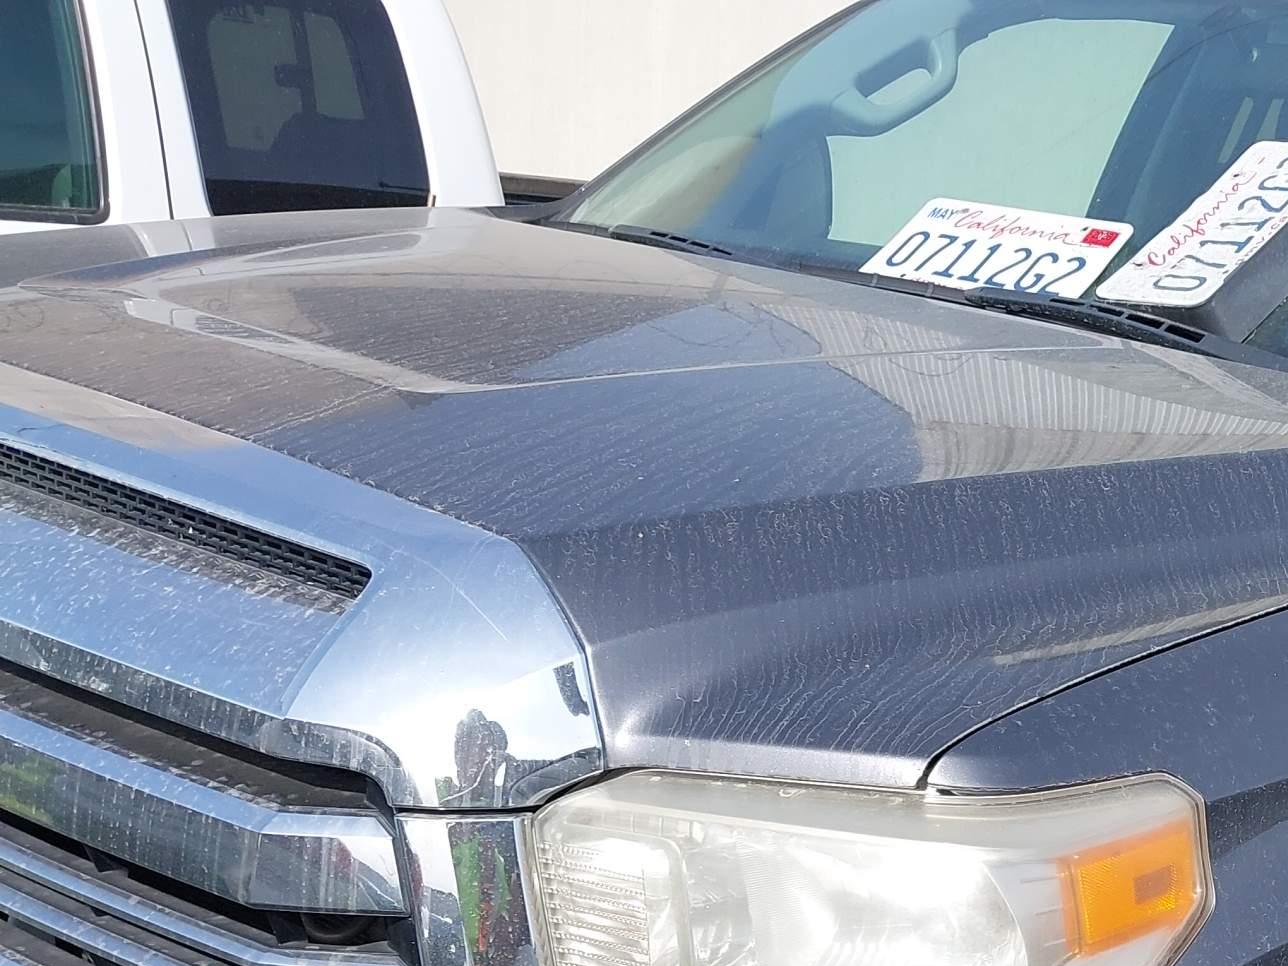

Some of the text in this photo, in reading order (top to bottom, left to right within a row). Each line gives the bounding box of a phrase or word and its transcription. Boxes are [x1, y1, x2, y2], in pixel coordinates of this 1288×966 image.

[927, 206, 957, 220] MAY
[953, 209, 1076, 246] California
[1147, 170, 1257, 267] California
[885, 230, 1088, 298] 07112G2
